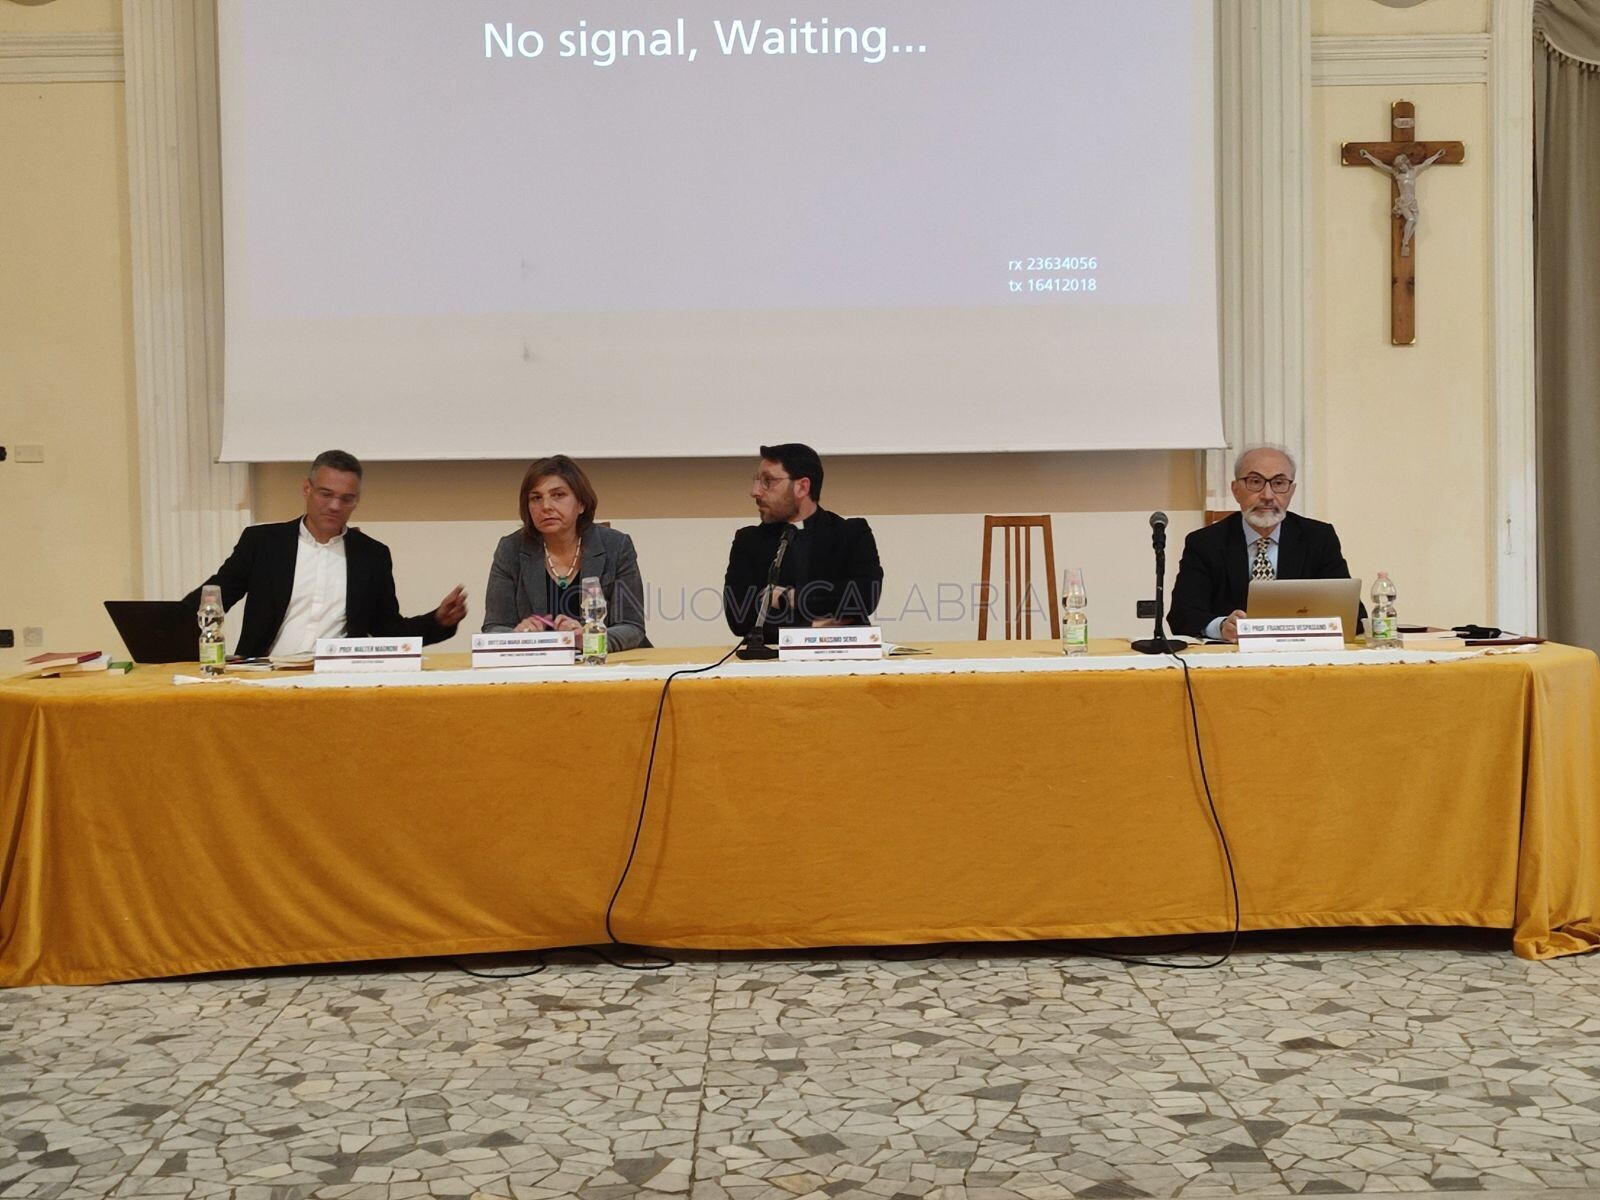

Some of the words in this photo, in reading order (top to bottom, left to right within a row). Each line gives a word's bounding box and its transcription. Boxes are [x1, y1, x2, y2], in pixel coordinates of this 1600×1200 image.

[484, 22, 544, 58] No
[559, 18, 698, 67] signal,
[714, 17, 927, 64] Waiting...
[1008, 260, 1023, 271] rx
[1027, 256, 1098, 271] 23634056
[1008, 279, 1023, 292] tx
[1028, 278, 1097, 292] 16412018
